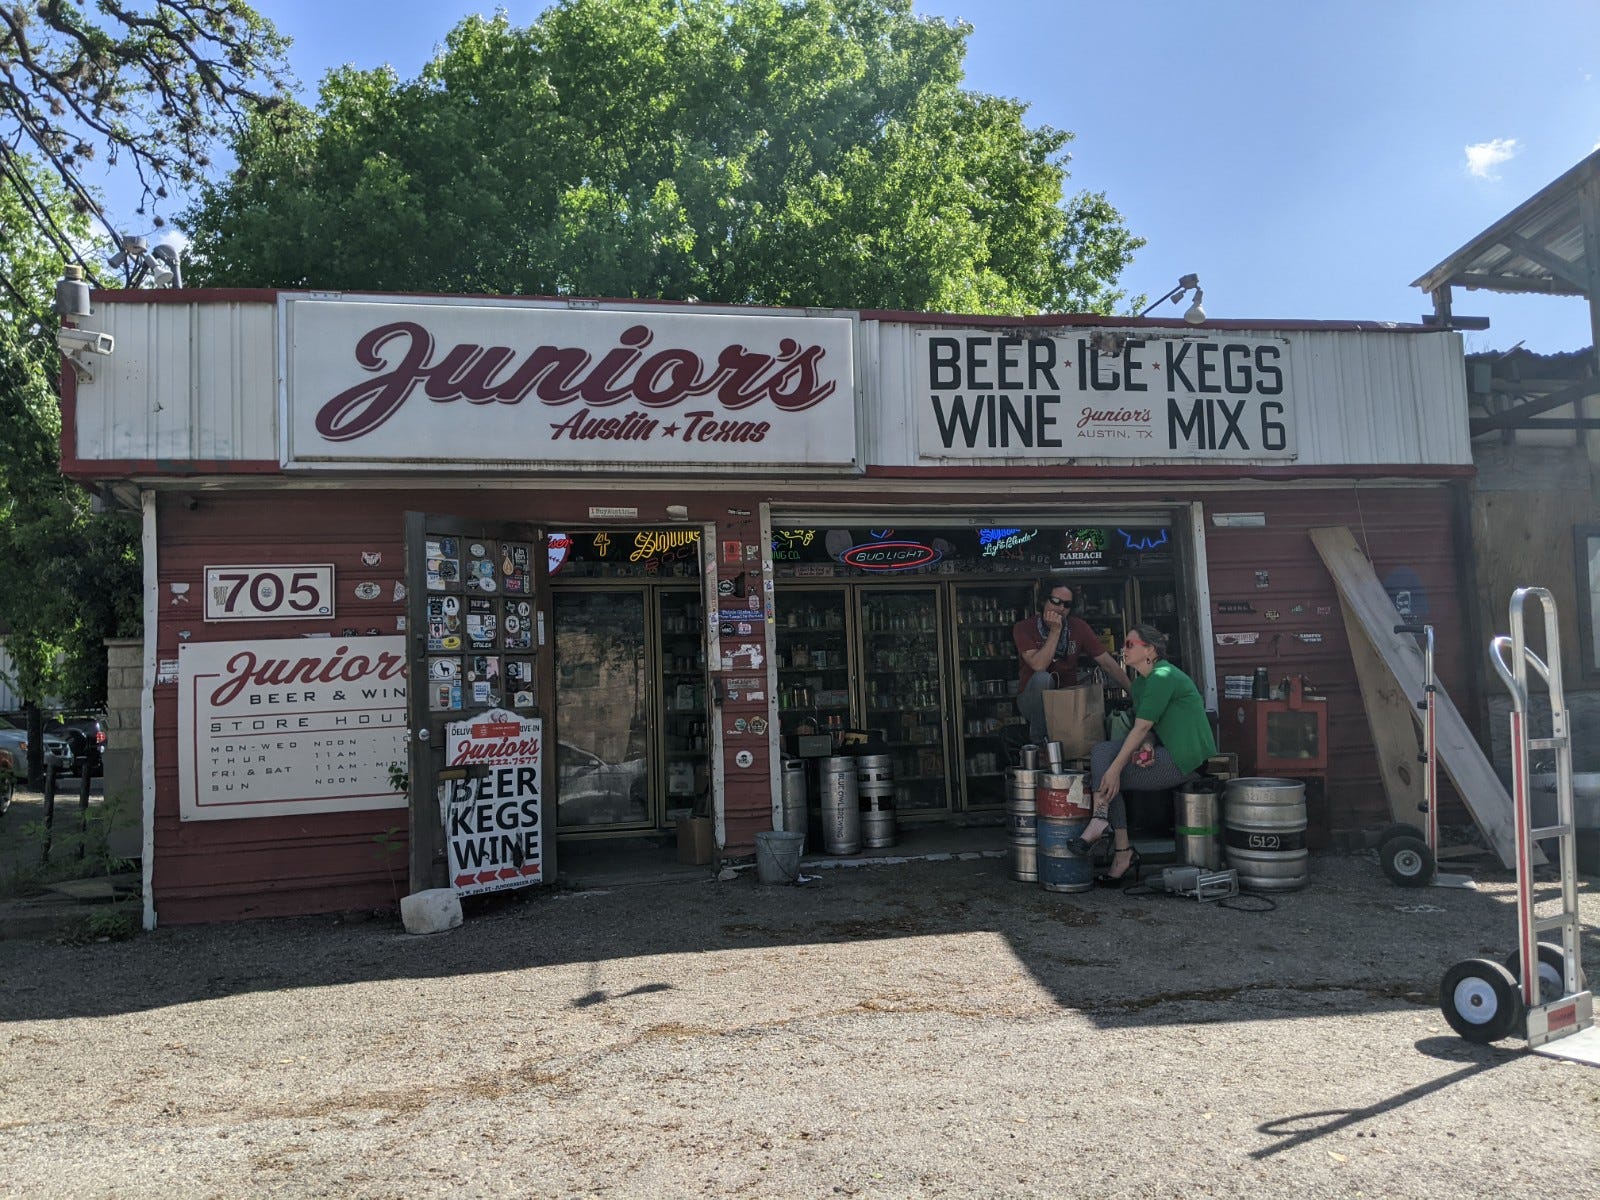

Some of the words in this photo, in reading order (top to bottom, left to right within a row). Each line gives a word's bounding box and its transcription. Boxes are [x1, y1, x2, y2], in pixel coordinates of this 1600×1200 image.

[928, 337, 1060, 391] BEER
[1077, 339, 1149, 392] ICE
[1166, 341, 1284, 395] KEGS
[314, 321, 836, 443] Junior's
[549, 407, 659, 441] Austin
[683, 410, 771, 443] Texas
[930, 395, 1063, 448] WINE
[1167, 398, 1250, 450] MIX
[1260, 401, 1287, 451] 6
[1076, 407, 1153, 428] Junior's
[1136, 430, 1153, 438] TX
[770, 550, 788, 560] ING
[856, 552, 885, 562] BUD
[886, 550, 925, 560] LIGHT
[1060, 552, 1103, 560] KARBACH
[218, 573, 320, 612] 705
[210, 646, 408, 706] Junior
[250, 692, 316, 705] BEER
[333, 690, 347, 701] &
[362, 687, 406, 699] WIN
[210, 717, 310, 733] STORE
[452, 727, 473, 736] DELIV
[211, 742, 298, 754] MON-WED
[314, 739, 357, 748] NOON
[451, 737, 540, 766] Junior's
[212, 755, 267, 765] THUR
[247, 768, 256, 776] &
[265, 766, 292, 774] SAT
[375, 760, 407, 768] MIDN
[212, 783, 250, 792] SUN
[315, 776, 358, 785] NOON
[452, 767, 539, 803] BEER
[837, 773, 845, 790] BLUE
[837, 790, 845, 807] OWL
[452, 800, 539, 836] KEGS
[1248, 832, 1281, 850] (512)
[453, 831, 540, 870] WINE
